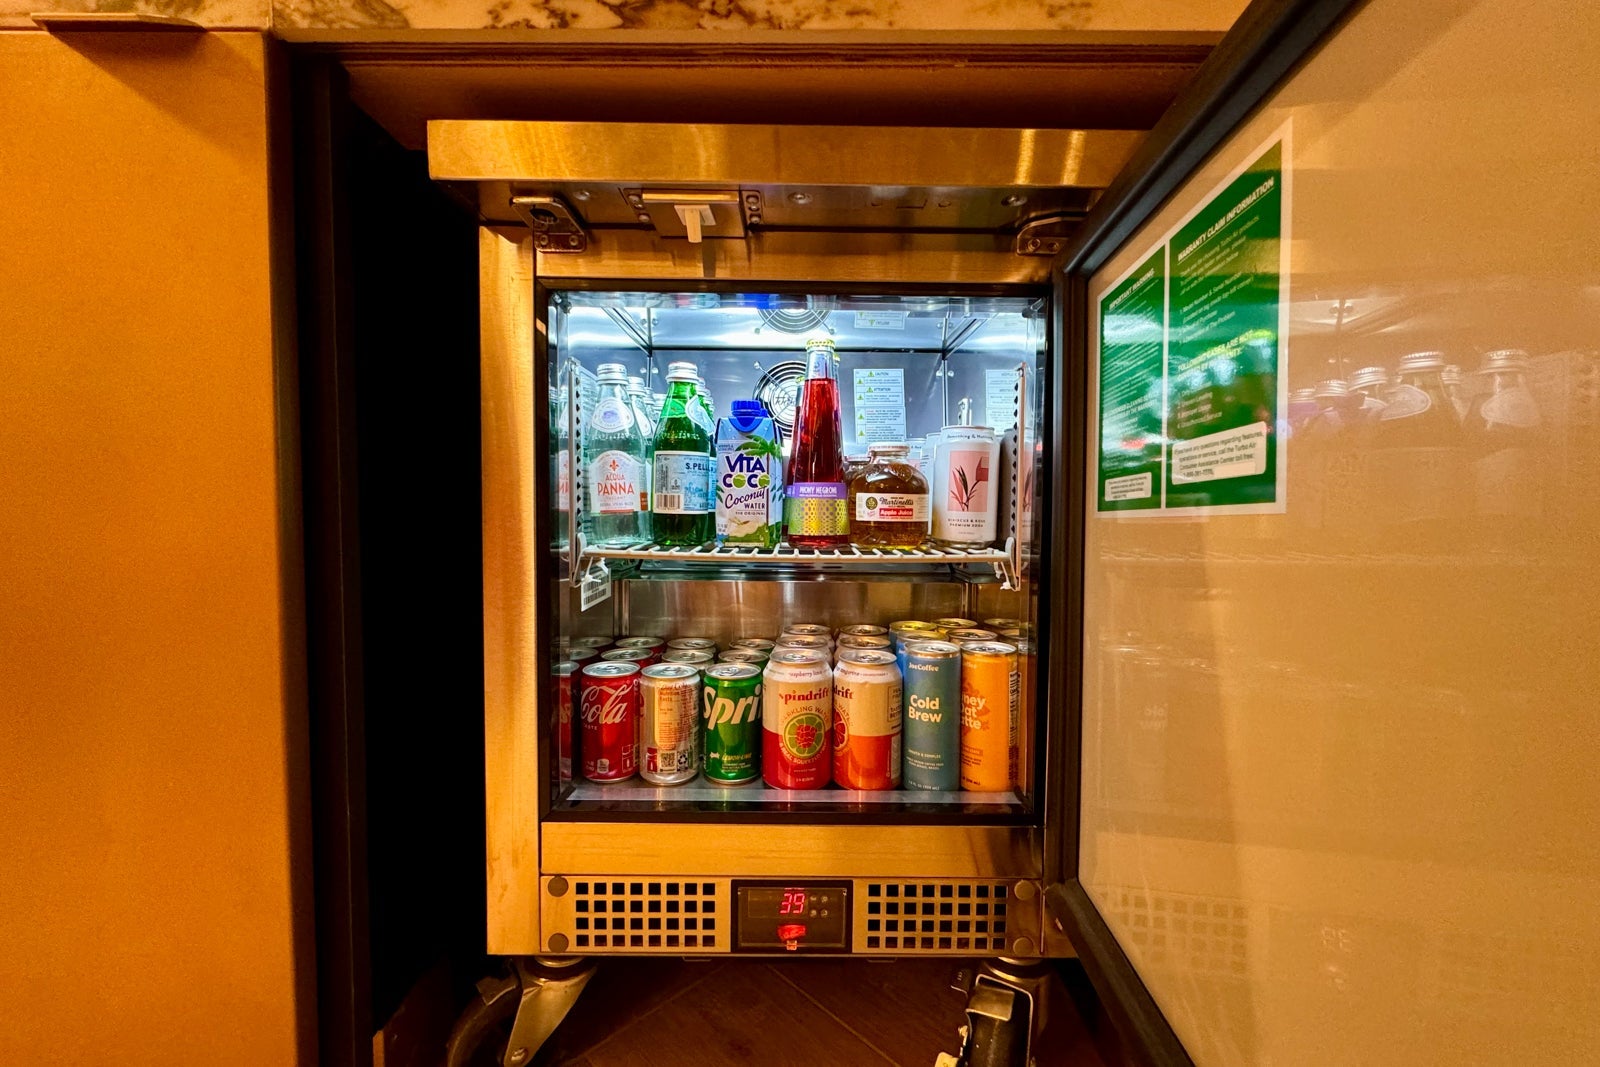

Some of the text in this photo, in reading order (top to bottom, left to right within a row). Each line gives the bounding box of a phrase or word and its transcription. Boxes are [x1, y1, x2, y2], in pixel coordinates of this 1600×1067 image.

[1178, 176, 1274, 262] WARRANTY CLAIM INFORMATION
[725, 453, 765, 472] VITA
[605, 473, 625, 481] ACQUA
[723, 474, 770, 488] COCO
[598, 482, 635, 496] PANNA
[724, 486, 767, 509] Coconut
[909, 662, 939, 671] JoeCoffee
[910, 695, 940, 710] Cold
[963, 695, 986, 710] ney
[909, 707, 942, 722] Brew
[962, 715, 982, 730] tte
[779, 893, 805, 914] 39
